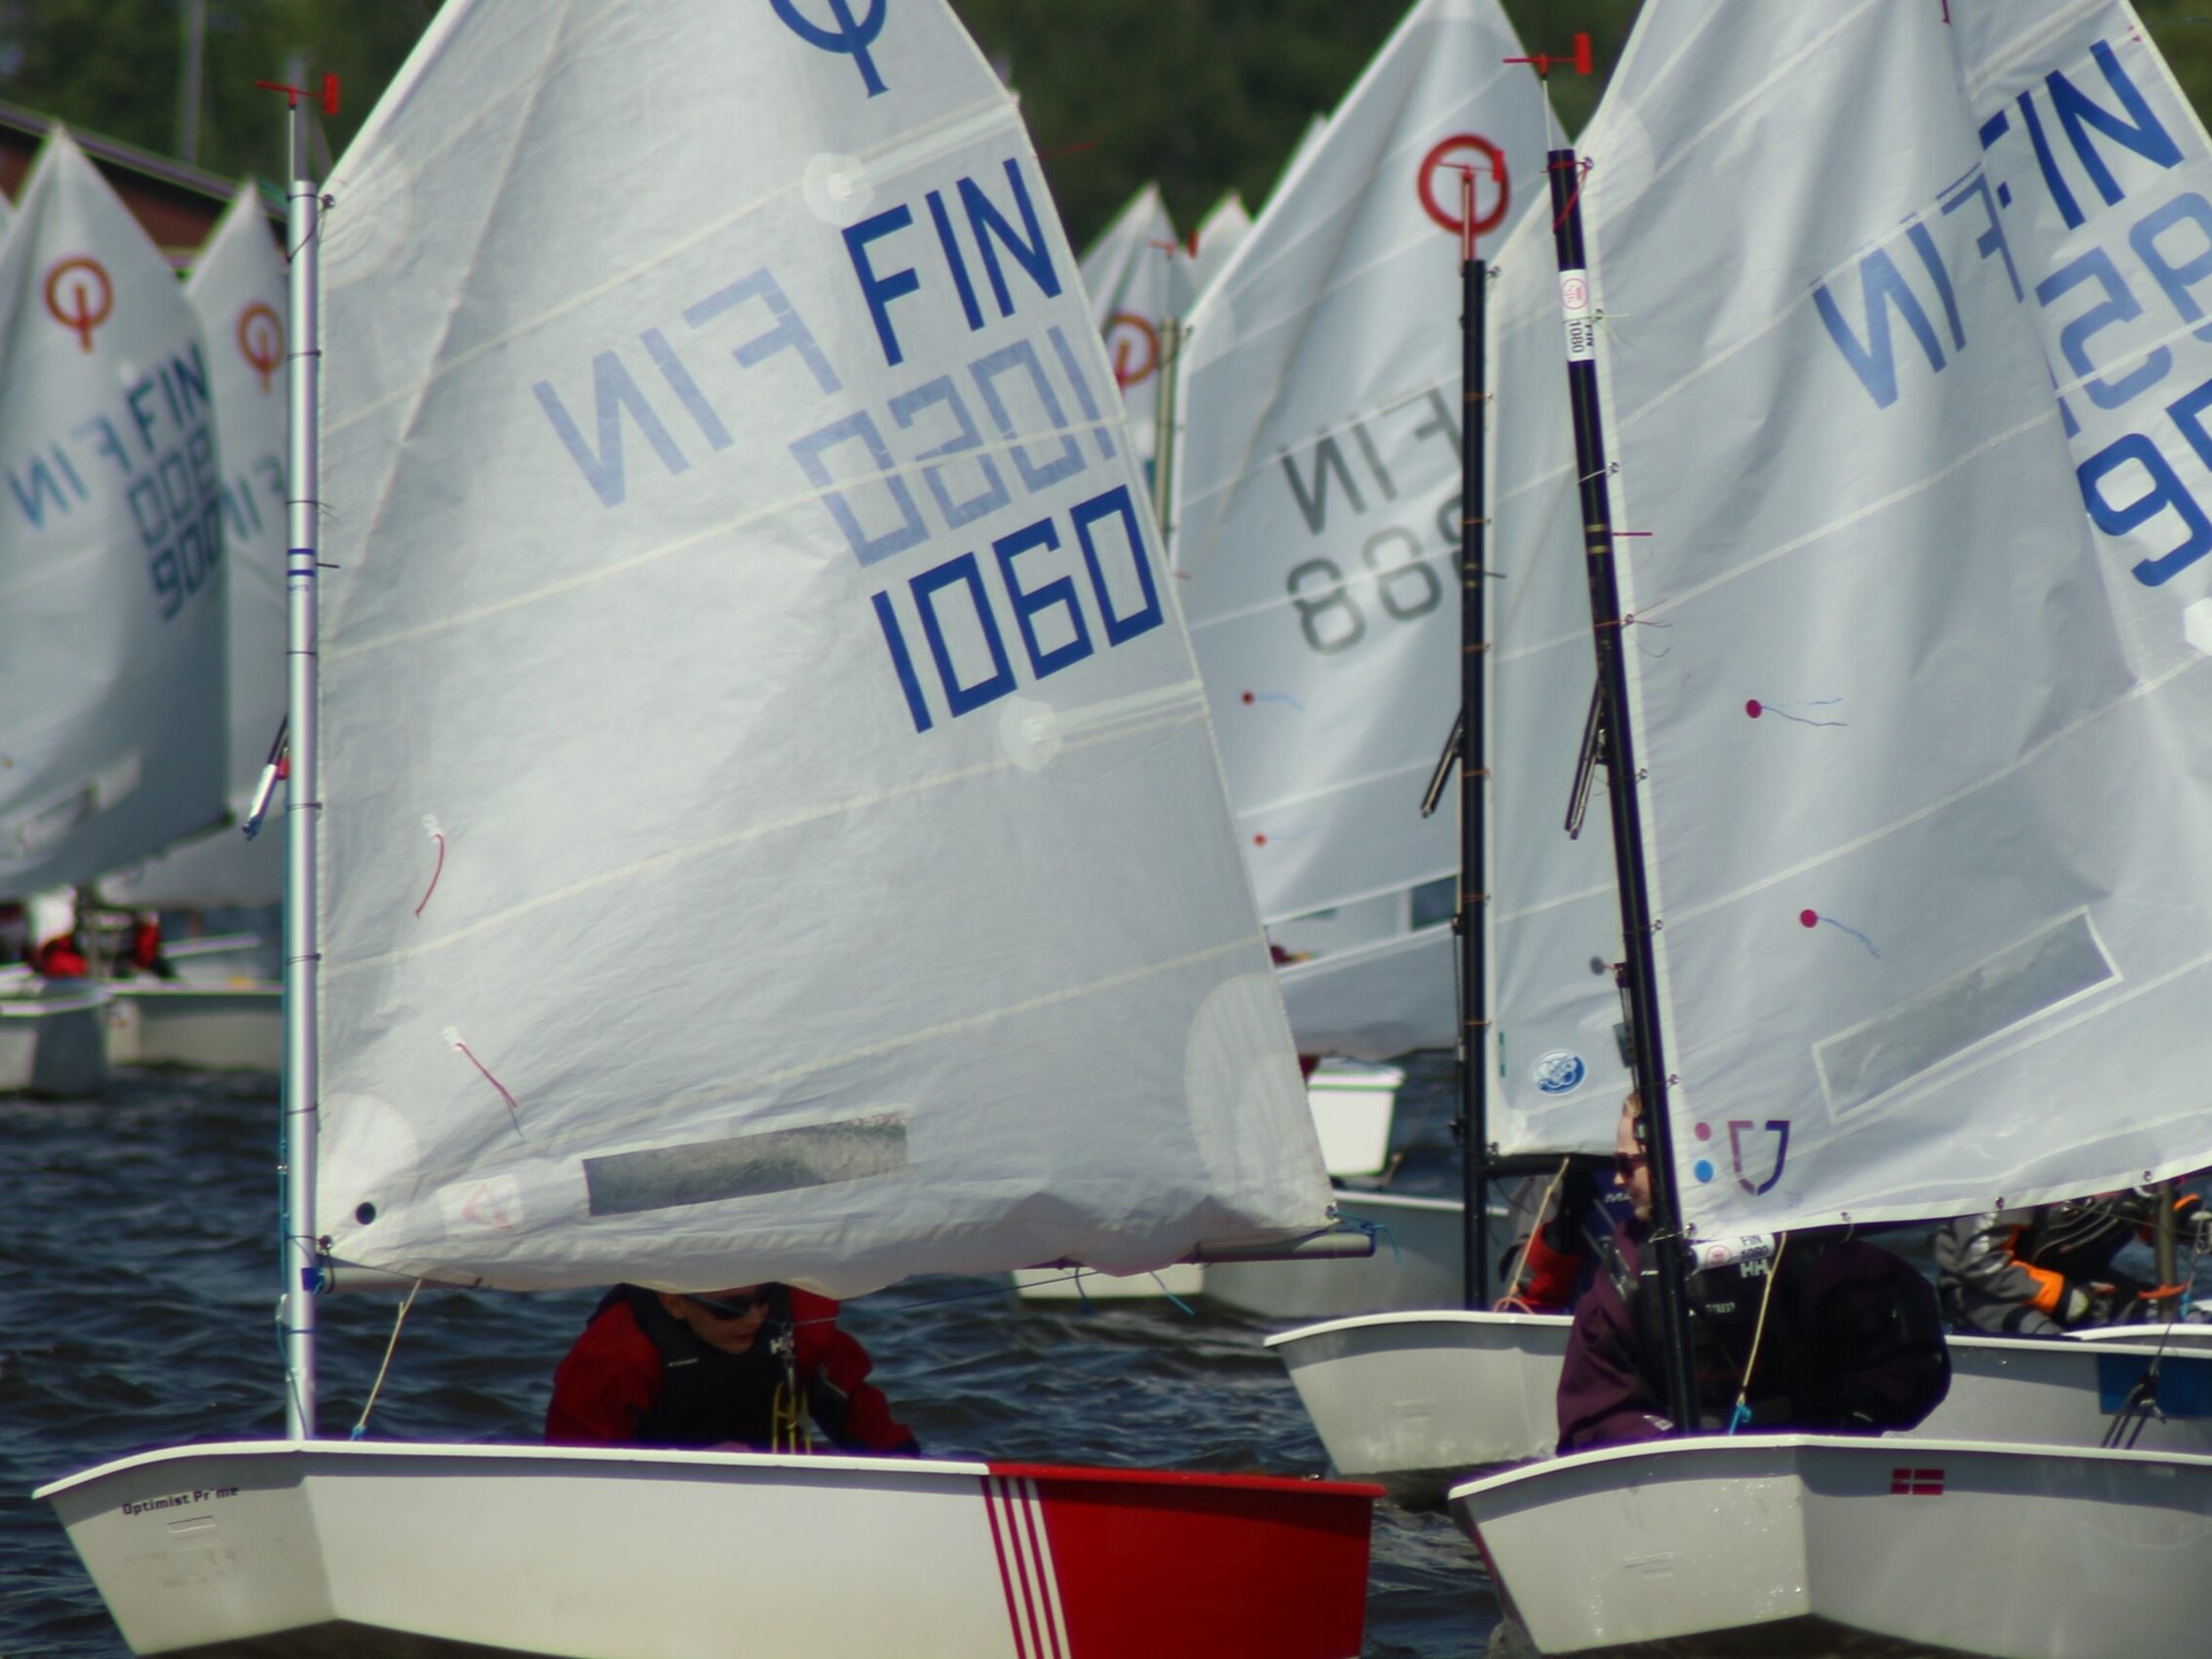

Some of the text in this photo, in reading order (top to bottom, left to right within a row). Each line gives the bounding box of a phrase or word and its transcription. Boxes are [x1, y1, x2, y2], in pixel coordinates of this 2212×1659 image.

[842, 157, 1062, 367] FIN
[126, 340, 209, 452] FIN
[871, 484, 1163, 734] 1060
[122, 1487, 239, 1515] Optimist Prme
